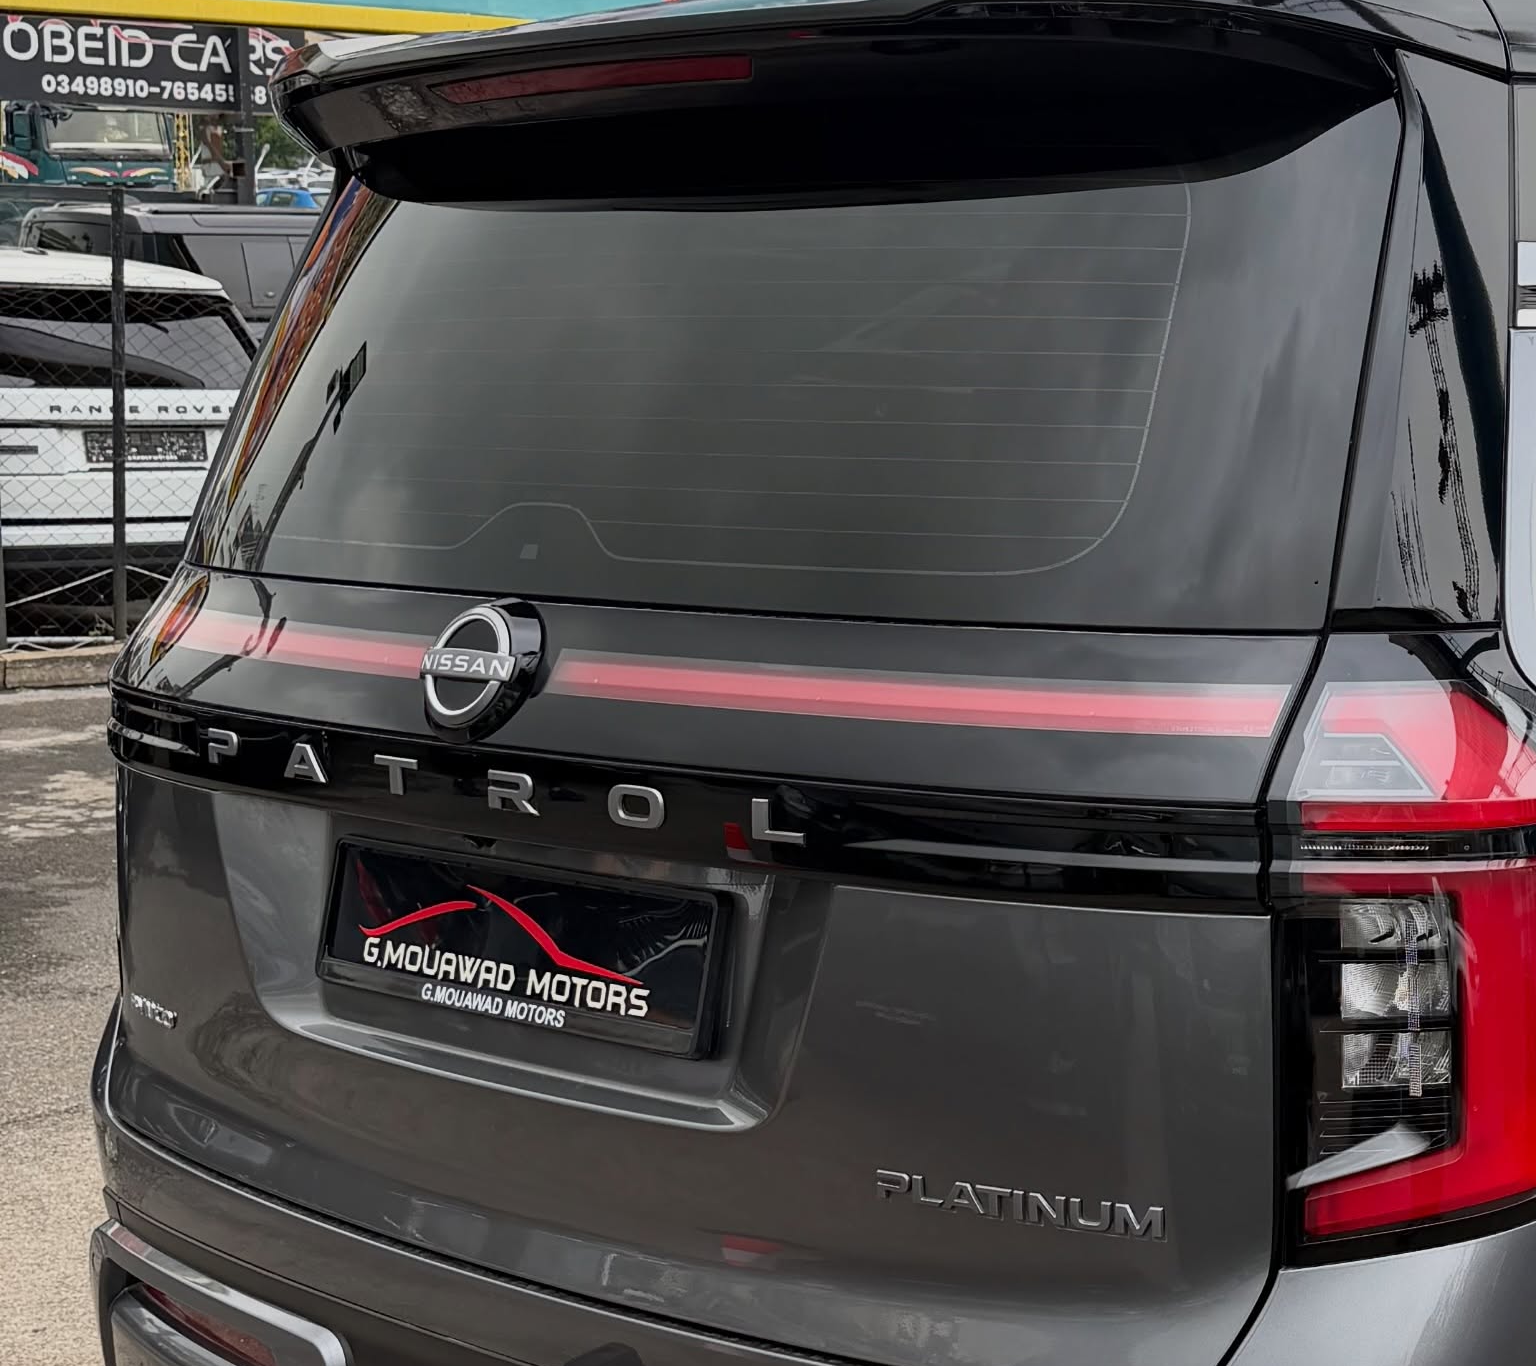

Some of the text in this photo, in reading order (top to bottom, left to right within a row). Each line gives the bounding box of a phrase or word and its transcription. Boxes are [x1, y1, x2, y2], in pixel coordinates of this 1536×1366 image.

[3, 21, 154, 69] OBEID
[50, 405, 140, 415] RANE
[422, 653, 510, 678] NISSAN
[207, 727, 806, 847] PATROL
[363, 936, 651, 1018] G.MOUAWAD MOTORS
[421, 982, 567, 1029] G.MOUAWAD MOTORS
[876, 1168, 1168, 1244] PLATINUM
